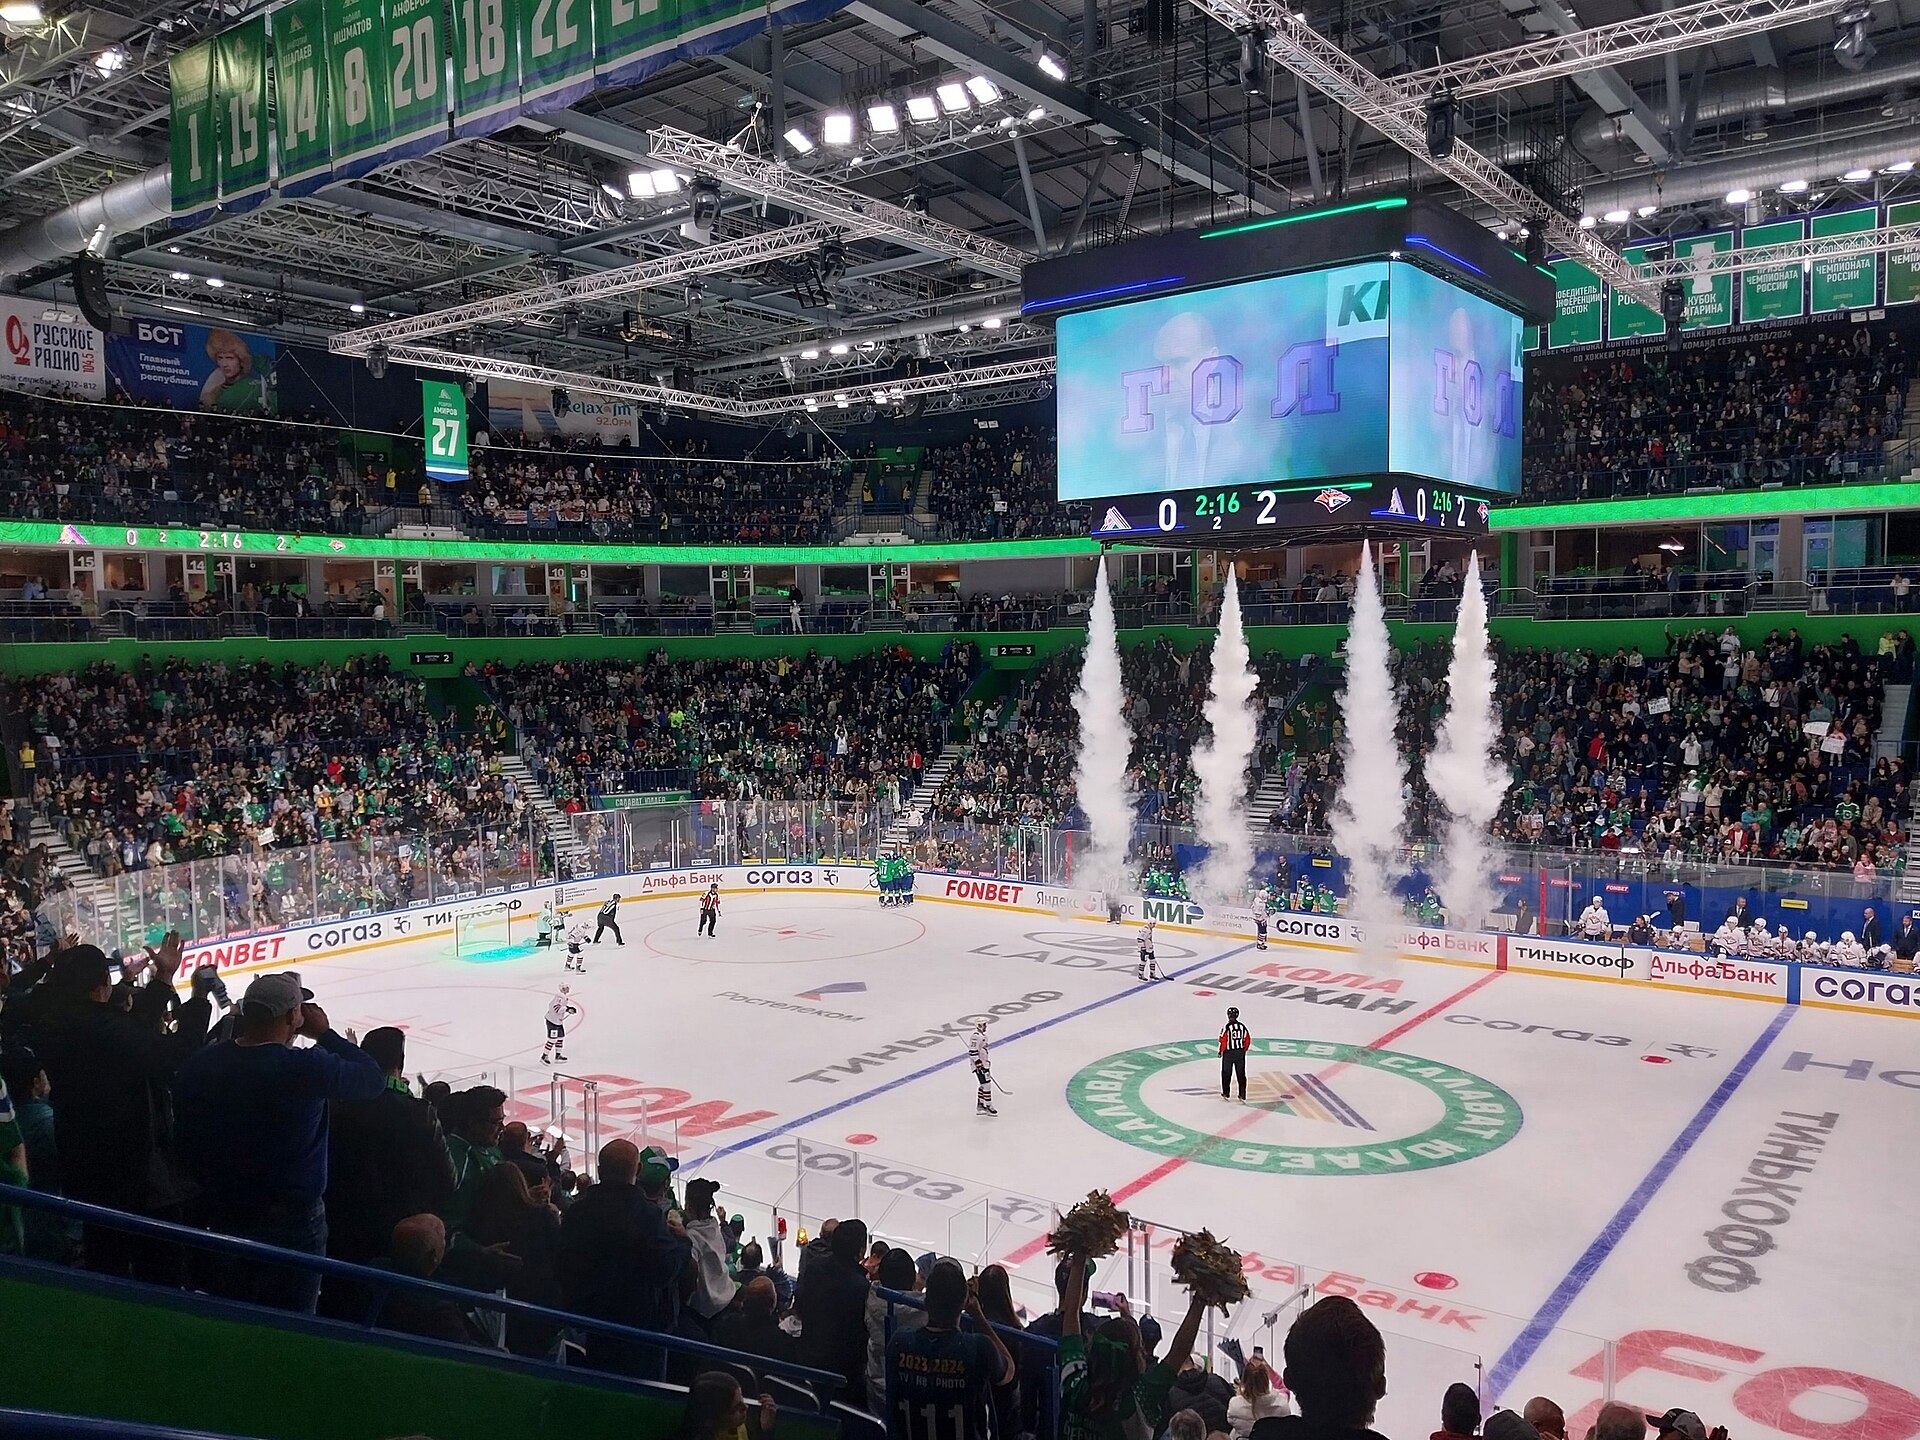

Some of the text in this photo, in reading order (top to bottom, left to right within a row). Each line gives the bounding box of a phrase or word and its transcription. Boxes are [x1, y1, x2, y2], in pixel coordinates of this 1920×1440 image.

[333, 17, 372, 46] ИШМАТОВ
[462, 0, 506, 84] 18
[283, 44, 312, 68] ШАЛАЕВ
[392, 15, 437, 109] 20
[344, 46, 367, 127] 8
[284, 66, 317, 150] 14
[229, 89, 259, 168] 15
[187, 113, 202, 183] 1
[1816, 259, 1871, 275] ЧЕМПИОНАТА
[1826, 270, 1860, 282] РОССИИ
[1746, 270, 1799, 285] ЧЕМПИОНАТА
[1756, 281, 1789, 293] РОССИИ
[1688, 293, 1717, 306] КУБОК
[1561, 304, 1589, 316] ВОСТОК
[1811, 311, 1845, 323] РОССИИ
[33, 323, 94, 351] РУССКОЕ
[137, 323, 183, 346] БСТ
[1573, 353, 1583, 363] ПО
[1584, 350, 1615, 362] ХОККЕЮ
[1617, 347, 1641, 358] СРЕДИ
[1682, 340, 1716, 351] КОМАНД
[1717, 335, 1748, 346] СЕЗОНА
[34, 347, 80, 372] РАДИО
[139, 353, 181, 366] Главный
[140, 364, 190, 376] телеканал
[140, 374, 199, 387] республики
[1120, 337, 1341, 434] ГОЛ
[433, 406, 458, 416] АМИРОВ
[432, 418, 460, 457] 27
[1158, 489, 1277, 532] 0 2:16 2
[1416, 487, 1466, 527] 0 2:16 2
[1212, 516, 1222, 530] 2
[1440, 514, 1446, 526] 2
[126, 529, 286, 551] 0 2 2:16 2
[1393, 543, 1400, 553] 2
[78, 556, 95, 567] 15
[190, 560, 205, 571] 14
[217, 561, 232, 573] 13
[1184, 555, 1192, 565] 4
[1207, 554, 1214, 564] 3
[381, 566, 395, 575] 12
[406, 566, 419, 575] 11
[551, 568, 565, 577] 10
[580, 569, 588, 578] 9
[721, 569, 729, 579] 8
[743, 570, 750, 579] 7
[879, 567, 886, 577] 6
[900, 567, 908, 576] 5
[443, 654, 450, 662] 2
[642, 872, 724, 888] Альфа Банк
[1605, 885, 1630, 893] FONBET
[946, 880, 1024, 904] FONBET
[1036, 890, 1079, 909] Яндекс
[1142, 901, 1205, 925] МИР
[1444, 934, 1490, 953] Банк
[180, 936, 286, 978] FONBET
[967, 943, 1140, 977] LADA
[1515, 946, 1635, 970] ТИНЬКОФФ
[1247, 962, 1404, 993] КОЛА
[1651, 955, 1777, 985] Альфа Банк
[1184, 972, 1418, 1015] ШИХАН
[713, 990, 866, 1022] Ростелеком
[788, 990, 1064, 1085] ТИНЬКОФФ
[1145, 1042, 1336, 1062] ЮЛЕВ
[1683, 1111, 1840, 1293] ТИНЬКОФФ
[1311, 1272, 1487, 1333] Банк
[936, 1378, 966, 1389] PHOTO
